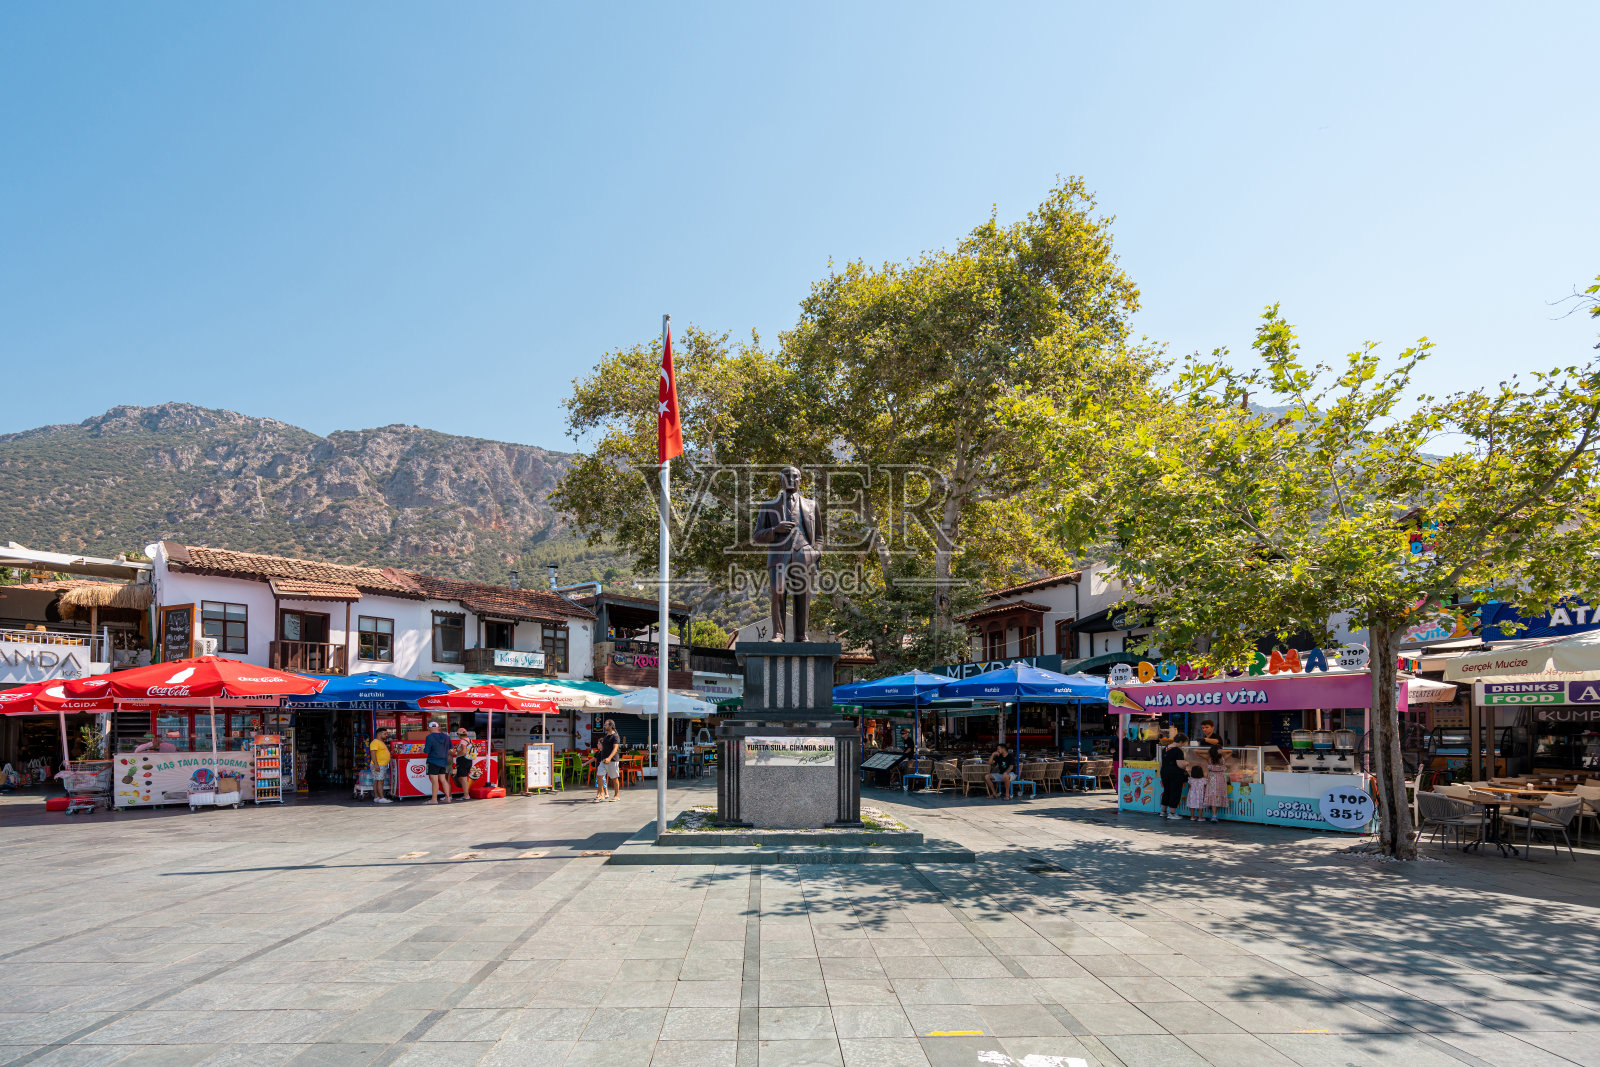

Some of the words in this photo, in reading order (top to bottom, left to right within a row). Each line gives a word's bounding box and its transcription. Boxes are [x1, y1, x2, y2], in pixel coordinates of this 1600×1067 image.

[1415, 626, 1449, 640] Vita
[1462, 663, 1492, 673] Gerçek
[1495, 658, 1529, 669] Mucize
[147, 685, 191, 697] Coca-Cola
[1491, 683, 1560, 693] DRINKS
[1145, 691, 1172, 706] MİA
[1176, 691, 1222, 705] DOLCE
[1226, 688, 1269, 704] VİTA
[1492, 694, 1555, 703] FOOD
[818, 744, 834, 752] SULH
[177, 759, 199, 768] TAVA
[1329, 794, 1335, 803] 1
[1339, 794, 1367, 805] TOP
